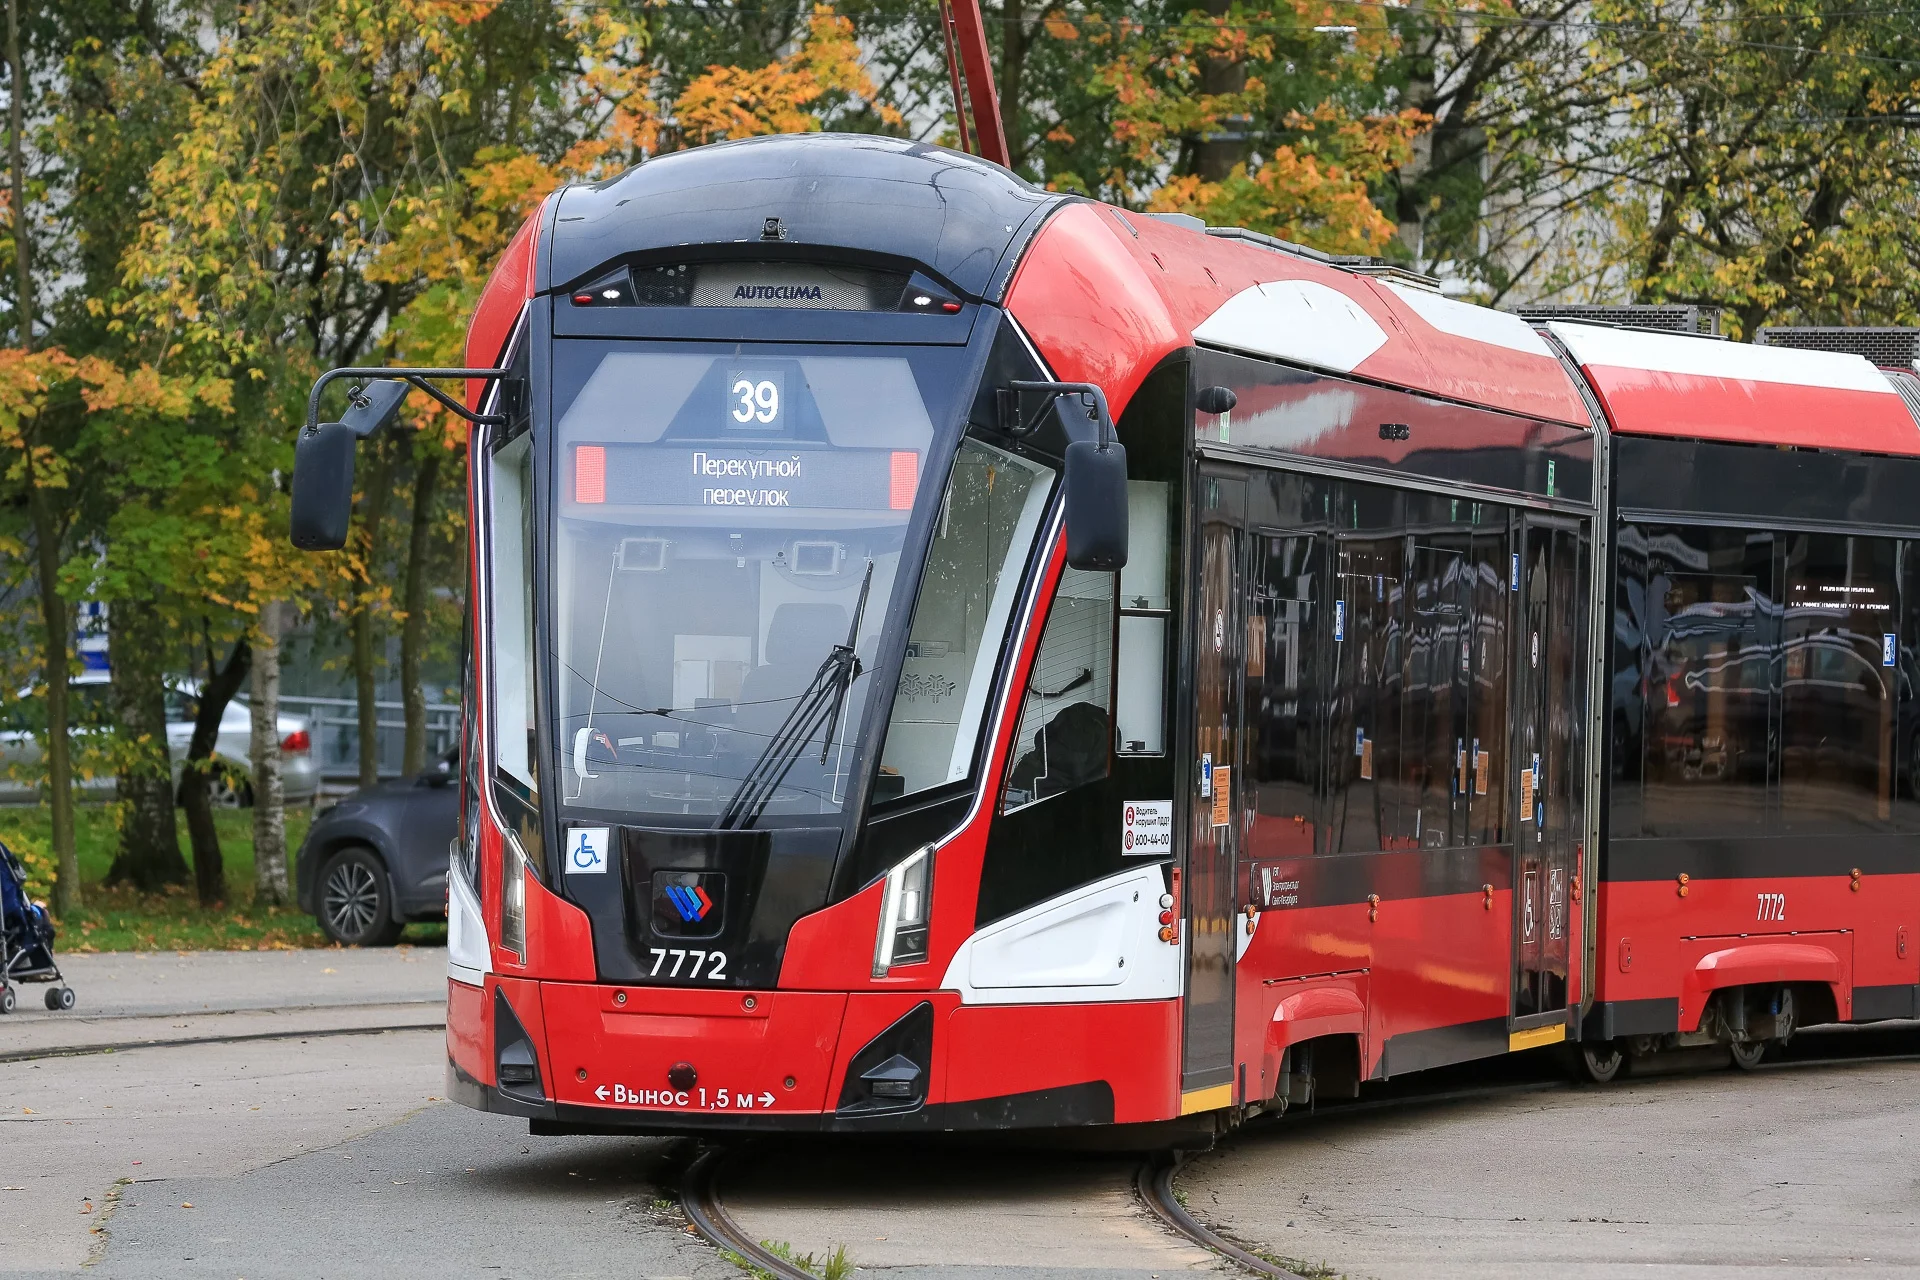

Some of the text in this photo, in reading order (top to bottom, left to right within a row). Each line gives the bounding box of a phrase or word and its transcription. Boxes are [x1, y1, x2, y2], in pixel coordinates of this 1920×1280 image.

[734, 285, 822, 301] AUTOCLIMA
[732, 380, 779, 423] 39
[693, 452, 801, 479] Перекупной
[703, 488, 789, 506] переулок
[1136, 806, 1158, 816] Водитель
[1135, 833, 1170, 845] 600-44-00
[1757, 893, 1785, 920] 7772
[649, 948, 727, 980] 7772
[614, 1084, 753, 1110] Вынос 1,5 м
